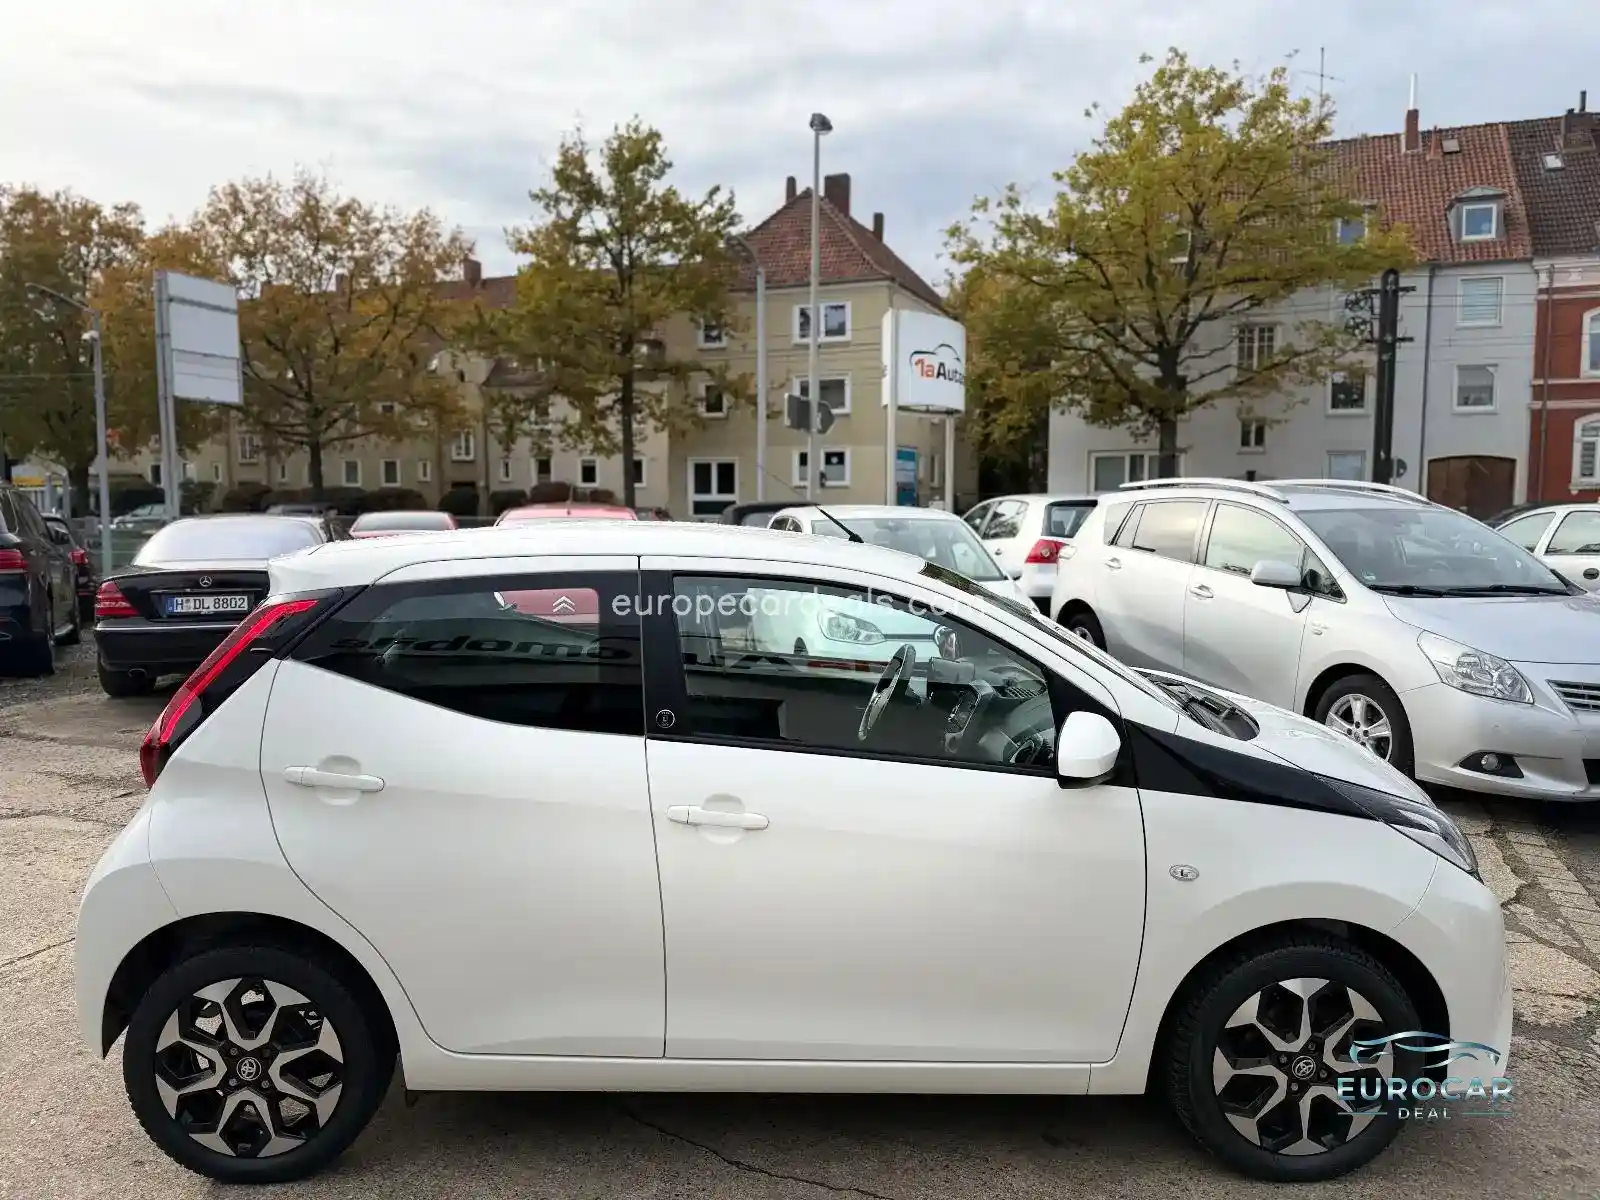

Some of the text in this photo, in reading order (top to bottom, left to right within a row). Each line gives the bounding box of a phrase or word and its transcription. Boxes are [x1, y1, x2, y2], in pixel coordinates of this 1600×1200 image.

[175, 598, 184, 611] H
[193, 598, 210, 610] DL
[213, 597, 246, 609] 8802
